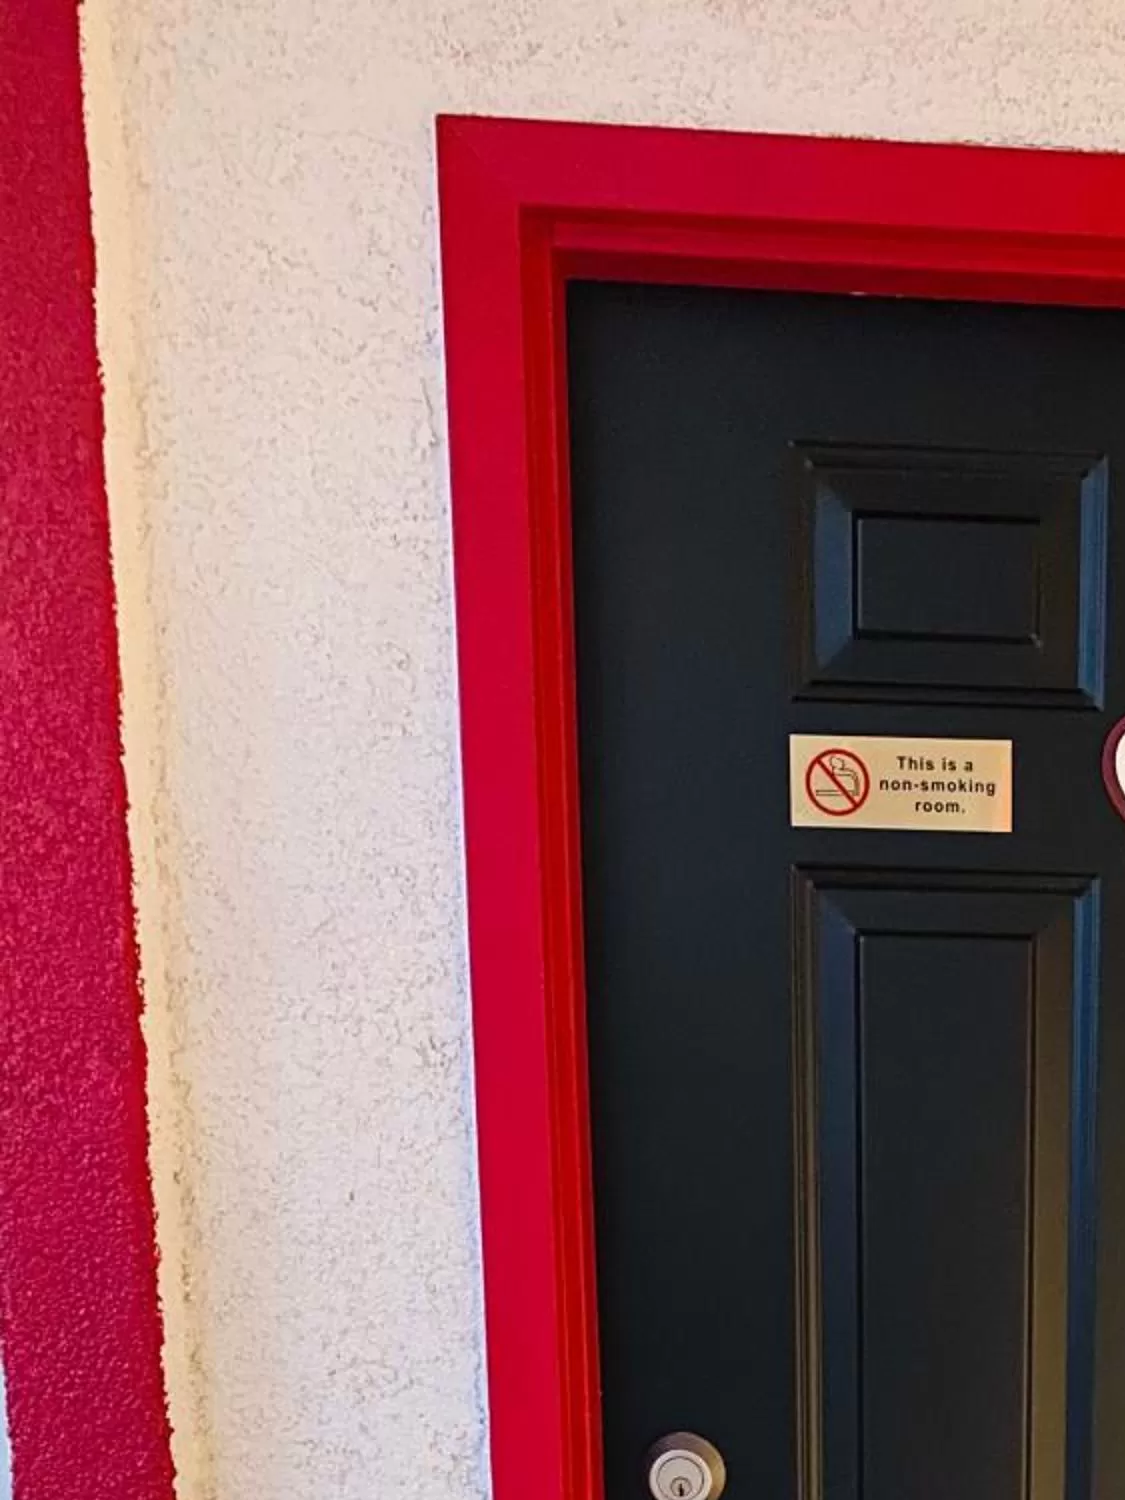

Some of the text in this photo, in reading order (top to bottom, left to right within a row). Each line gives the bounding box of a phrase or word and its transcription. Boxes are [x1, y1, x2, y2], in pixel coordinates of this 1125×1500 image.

[896, 756, 973, 772] This is a
[879, 778, 996, 796] non-smoking
[915, 801, 966, 814] room.
